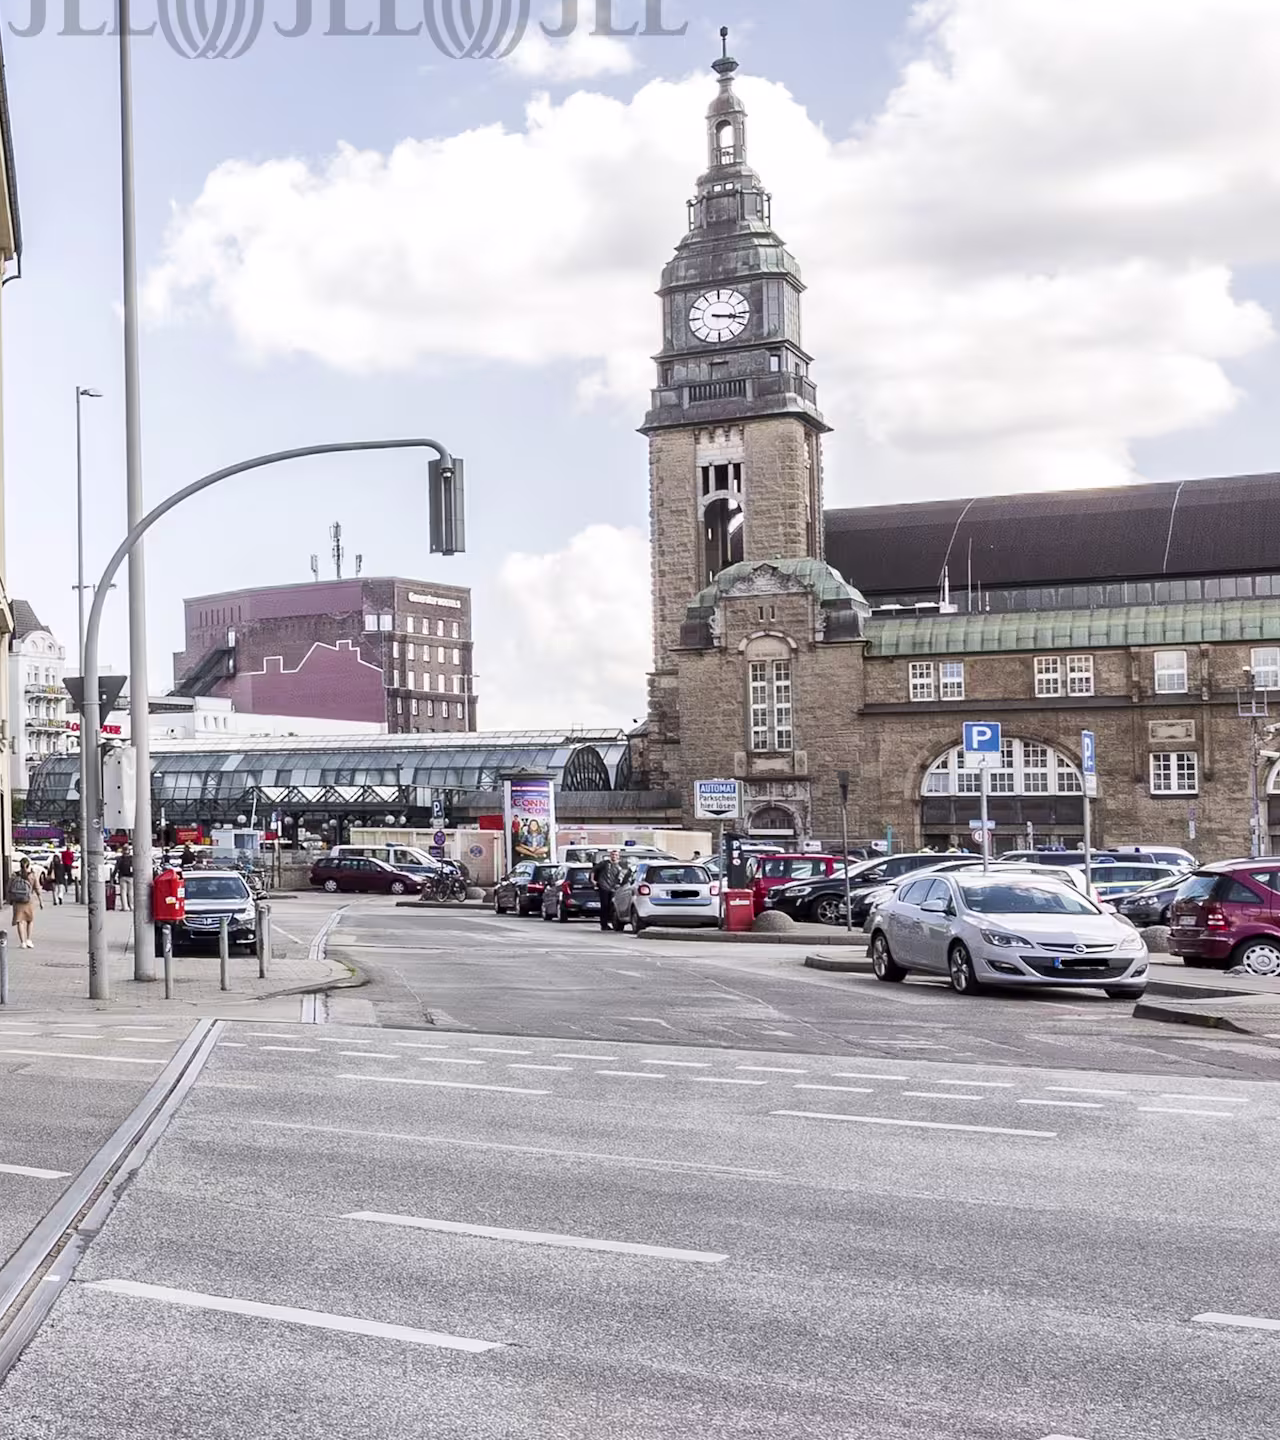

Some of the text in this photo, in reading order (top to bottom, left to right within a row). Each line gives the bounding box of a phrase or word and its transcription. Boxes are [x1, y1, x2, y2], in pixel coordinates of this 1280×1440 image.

[972, 726, 992, 749] P
[1084, 737, 1092, 768] P
[700, 784, 736, 793] AUTOMAT
[699, 794, 737, 802] Parkschein
[433, 801, 440, 817] P
[716, 801, 736, 809] lösen
